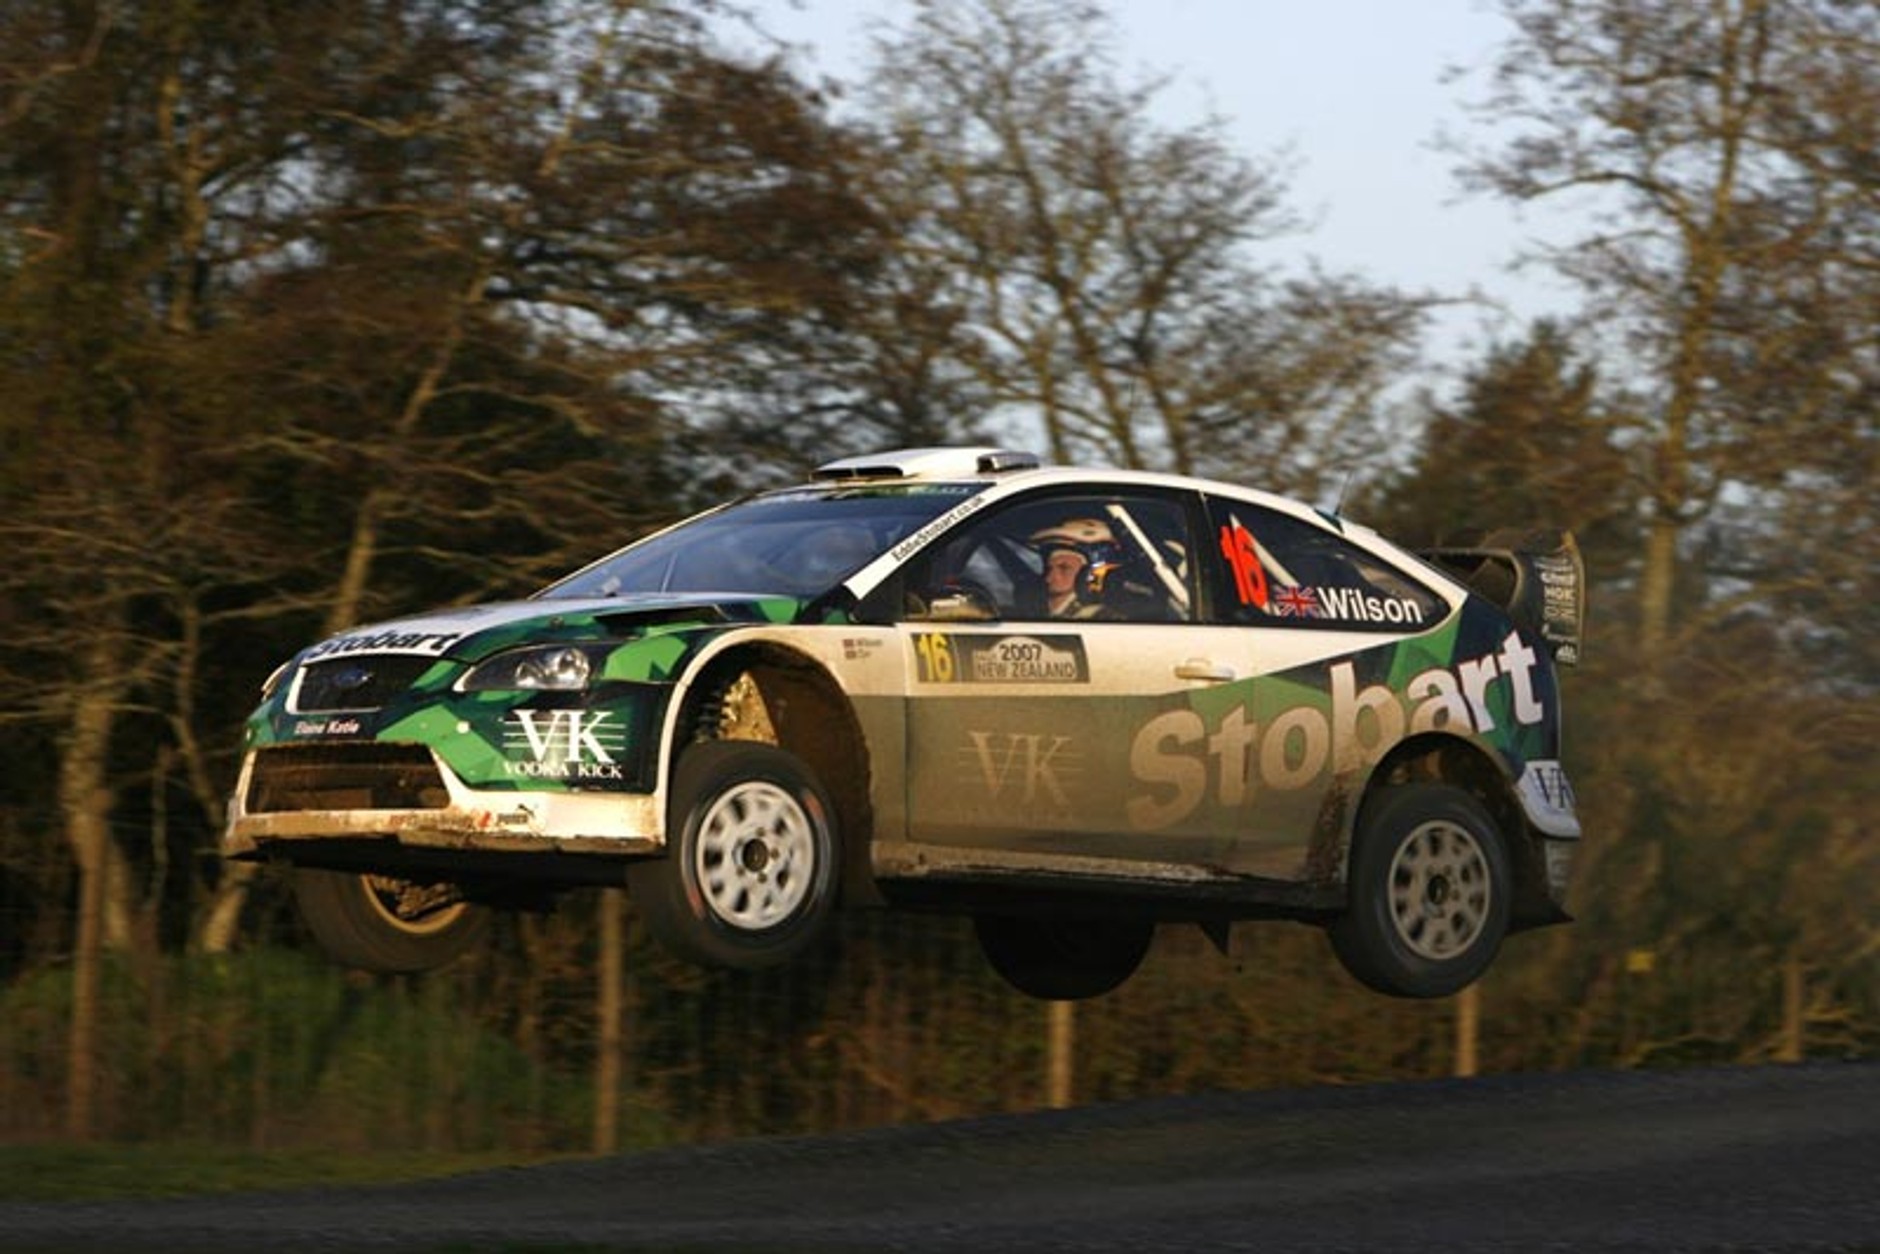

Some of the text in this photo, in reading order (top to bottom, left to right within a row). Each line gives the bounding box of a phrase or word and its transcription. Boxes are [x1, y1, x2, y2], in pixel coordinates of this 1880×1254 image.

[1219, 524, 1268, 608] 16
[1317, 586, 1423, 624] Wilson
[915, 633, 953, 682] 16
[977, 662, 1075, 678] NEW ZEALAND
[999, 643, 1043, 662] 2007
[511, 709, 614, 764] VK
[1128, 629, 1544, 832] Stobart
[503, 761, 623, 779] VODKA KICK
[967, 730, 1074, 806] VK
